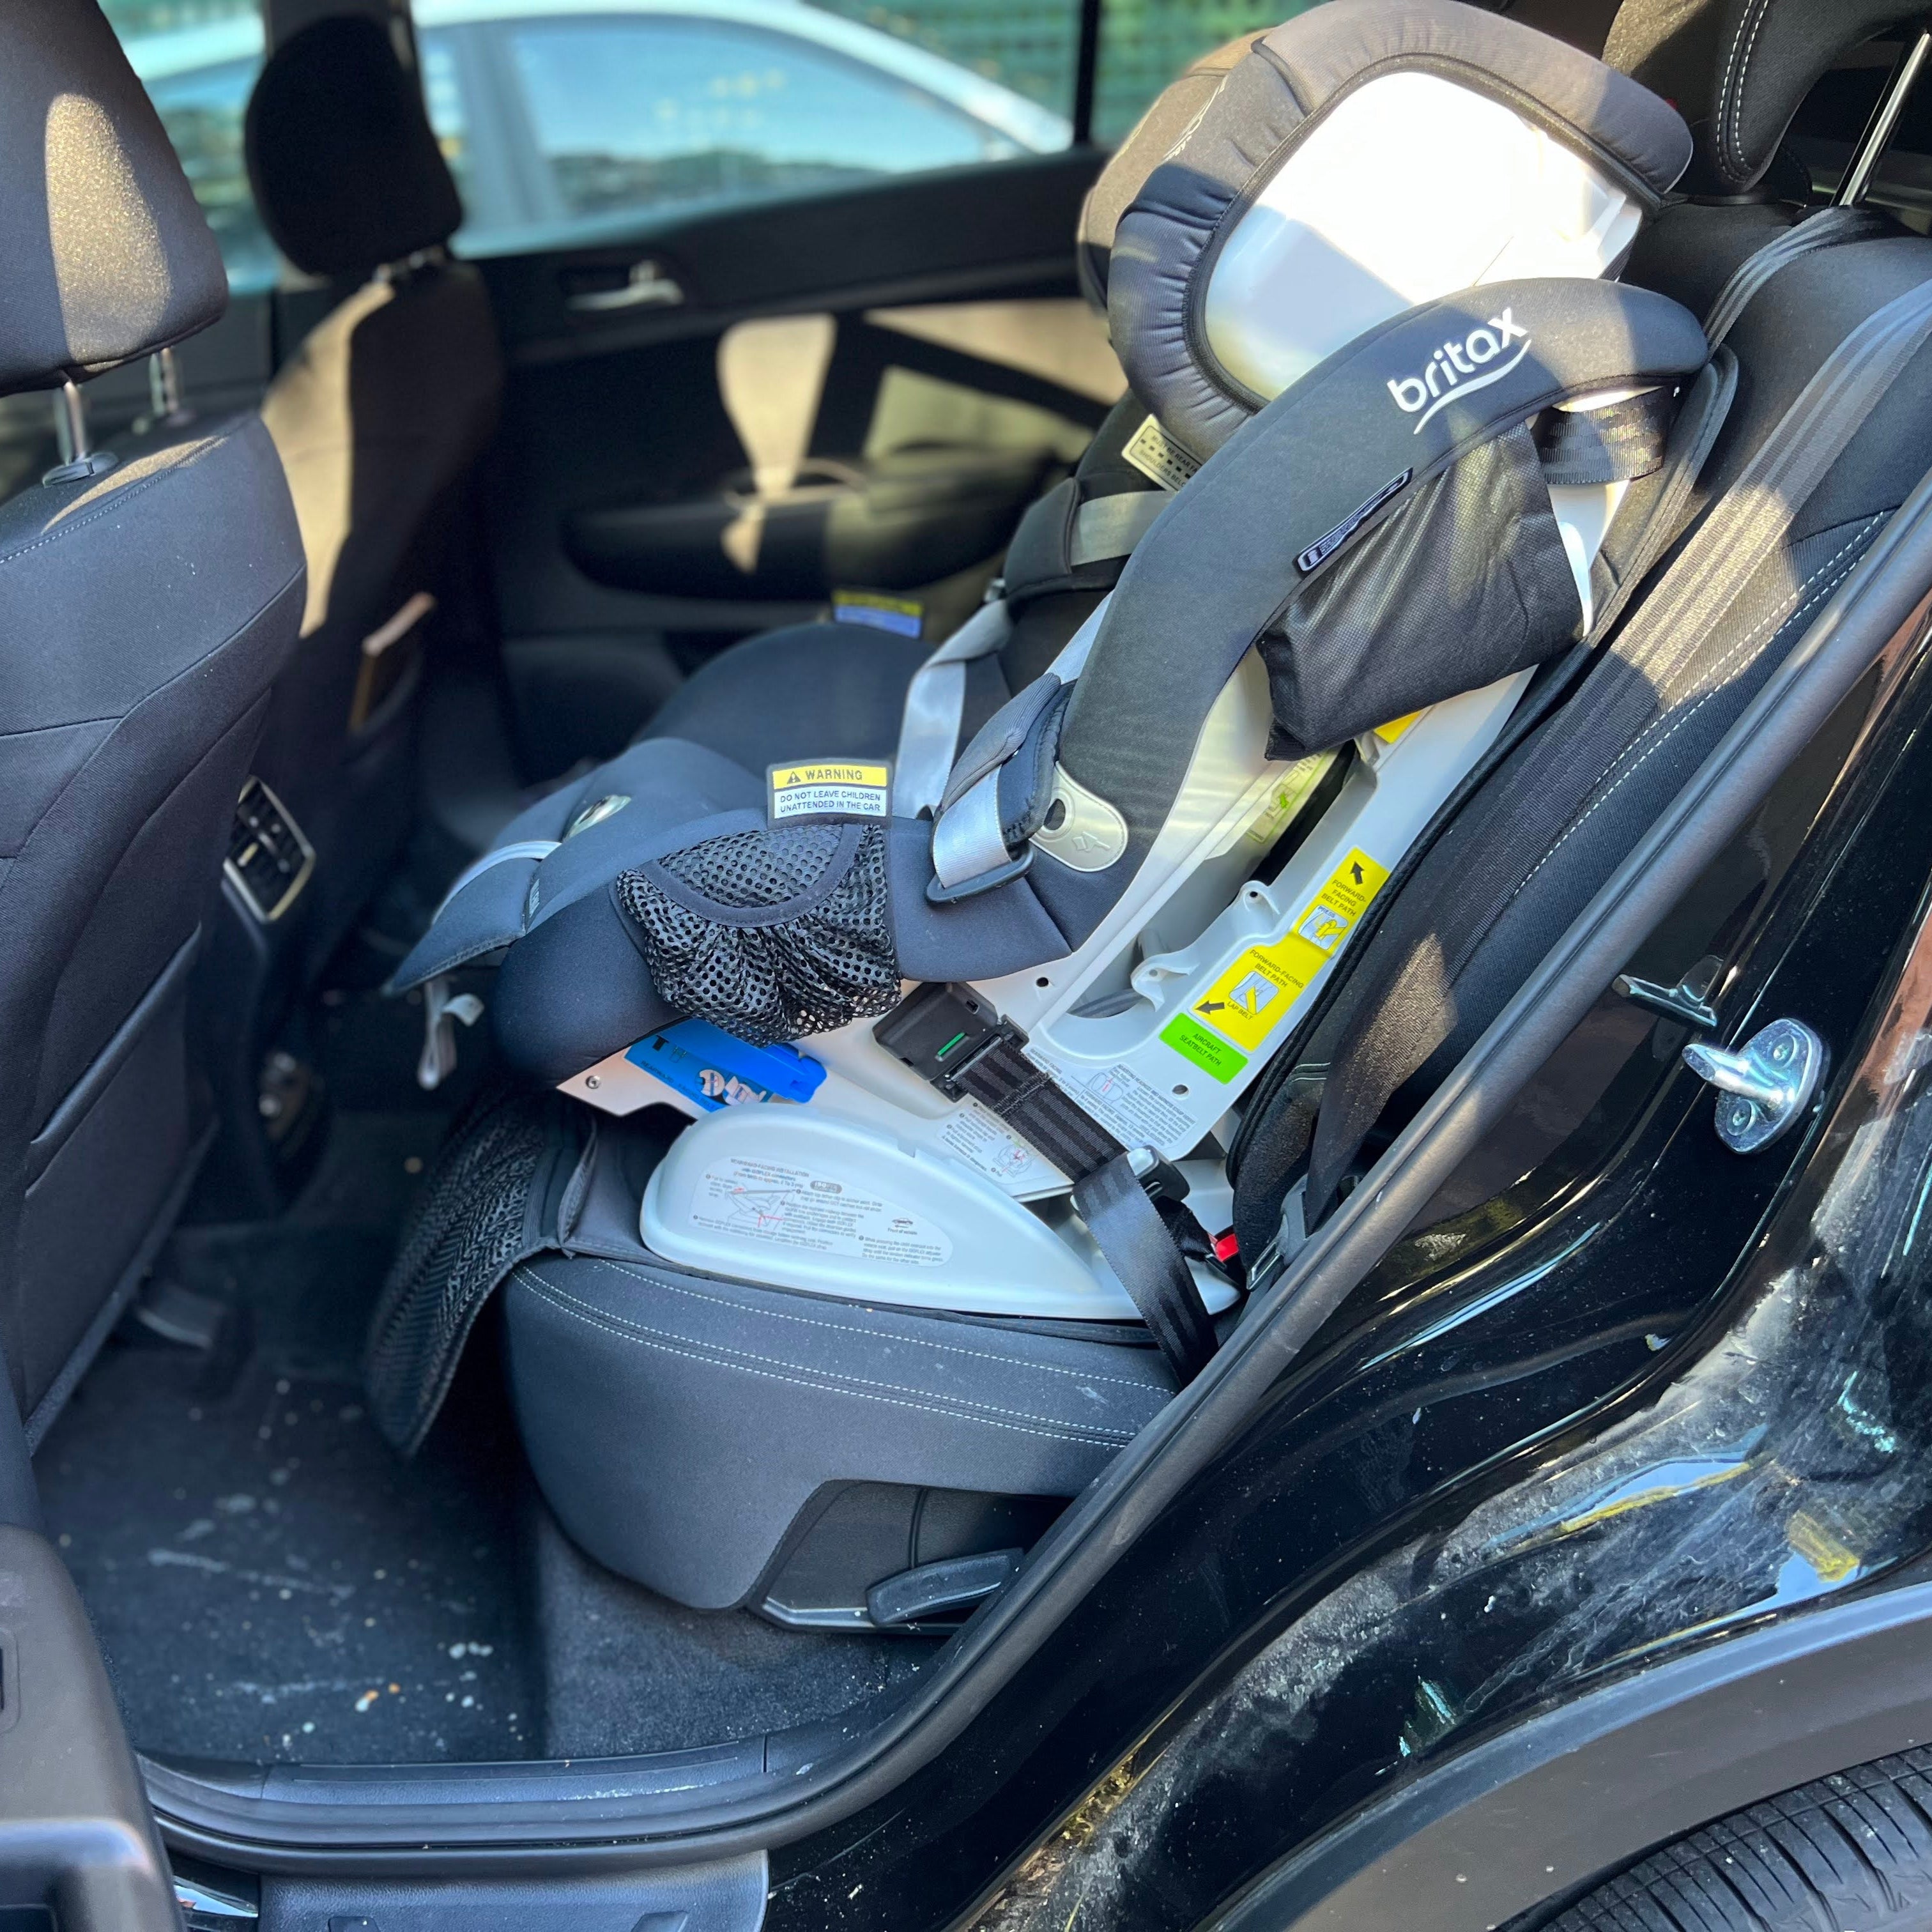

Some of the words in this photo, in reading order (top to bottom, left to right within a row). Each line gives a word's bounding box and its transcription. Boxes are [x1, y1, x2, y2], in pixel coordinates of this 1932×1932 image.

[1386, 307, 1528, 413] britax
[1152, 435, 1168, 448] MUST
[1167, 447, 1175, 456] BE
[1175, 454, 1190, 466] REAR
[1140, 450, 1172, 475] SHOULDERS
[805, 769, 862, 780] WARNING
[781, 794, 792, 802] DO
[795, 792, 811, 801] NOT
[841, 791, 880, 801] CHILDREN
[781, 801, 834, 813] UNATTENDED
[1332, 880, 1366, 902] FORWARD-
[1332, 889, 1357, 907] FACING
[1321, 893, 1339, 905] BELT
[1338, 903, 1356, 916] PATH
[1250, 949, 1304, 989] FORWARD-FACING
[1254, 963, 1270, 977] BELT
[1269, 972, 1287, 988] PATH
[1227, 1000, 1238, 1011] LAP
[1237, 1008, 1254, 1021] BELT
[1179, 1035, 1208, 1056] SEATBELT
[1206, 1053, 1222, 1066] PATH
[1193, 1033, 1222, 1053] AIRCRAFT
